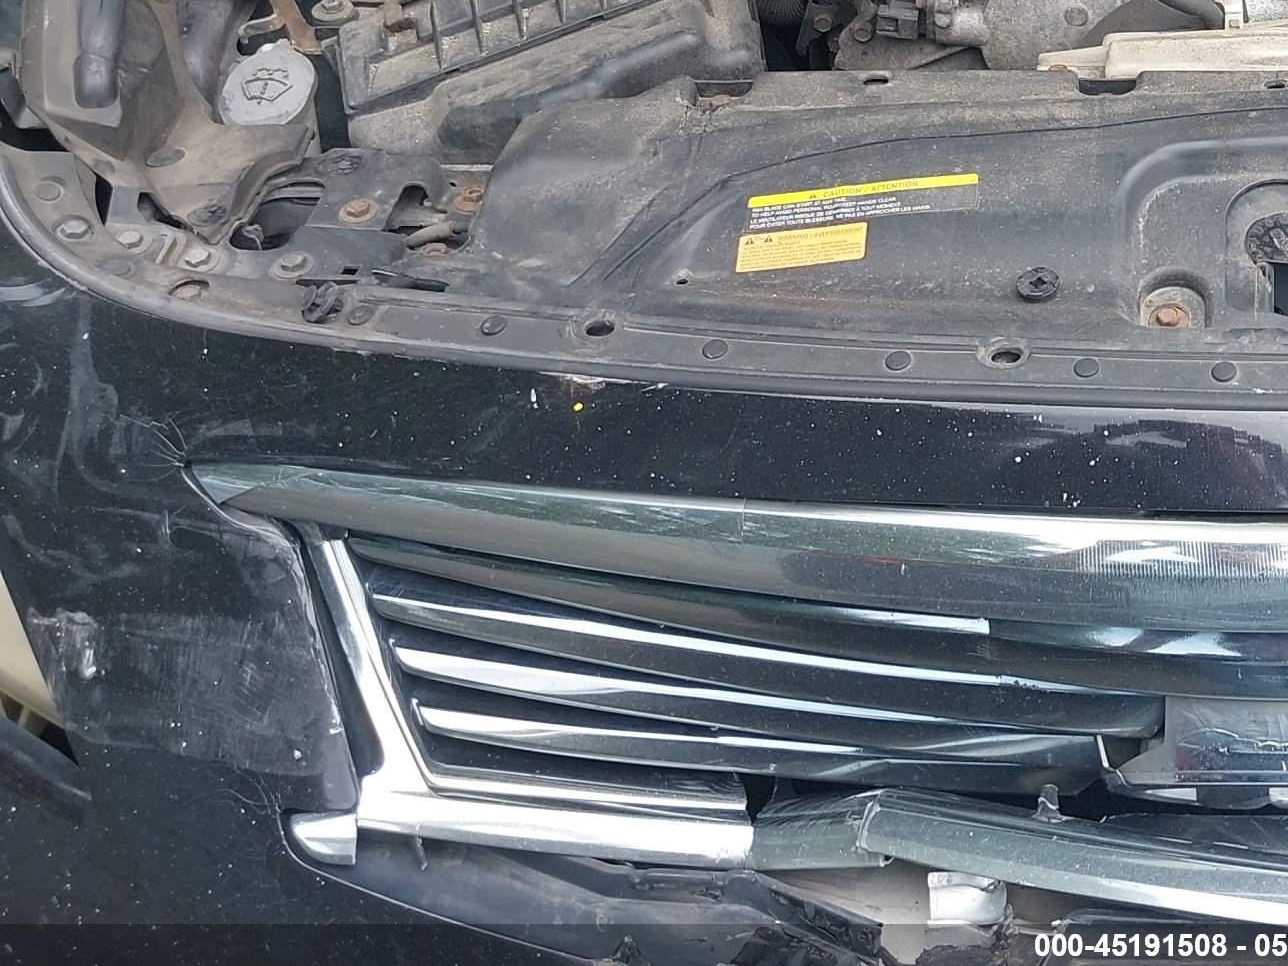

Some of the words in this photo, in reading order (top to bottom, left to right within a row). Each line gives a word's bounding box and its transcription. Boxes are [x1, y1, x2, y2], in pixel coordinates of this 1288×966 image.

[823, 187, 862, 198] CAUTION
[871, 180, 919, 192] ATTENTION
[786, 218, 805, 226] TOUTE
